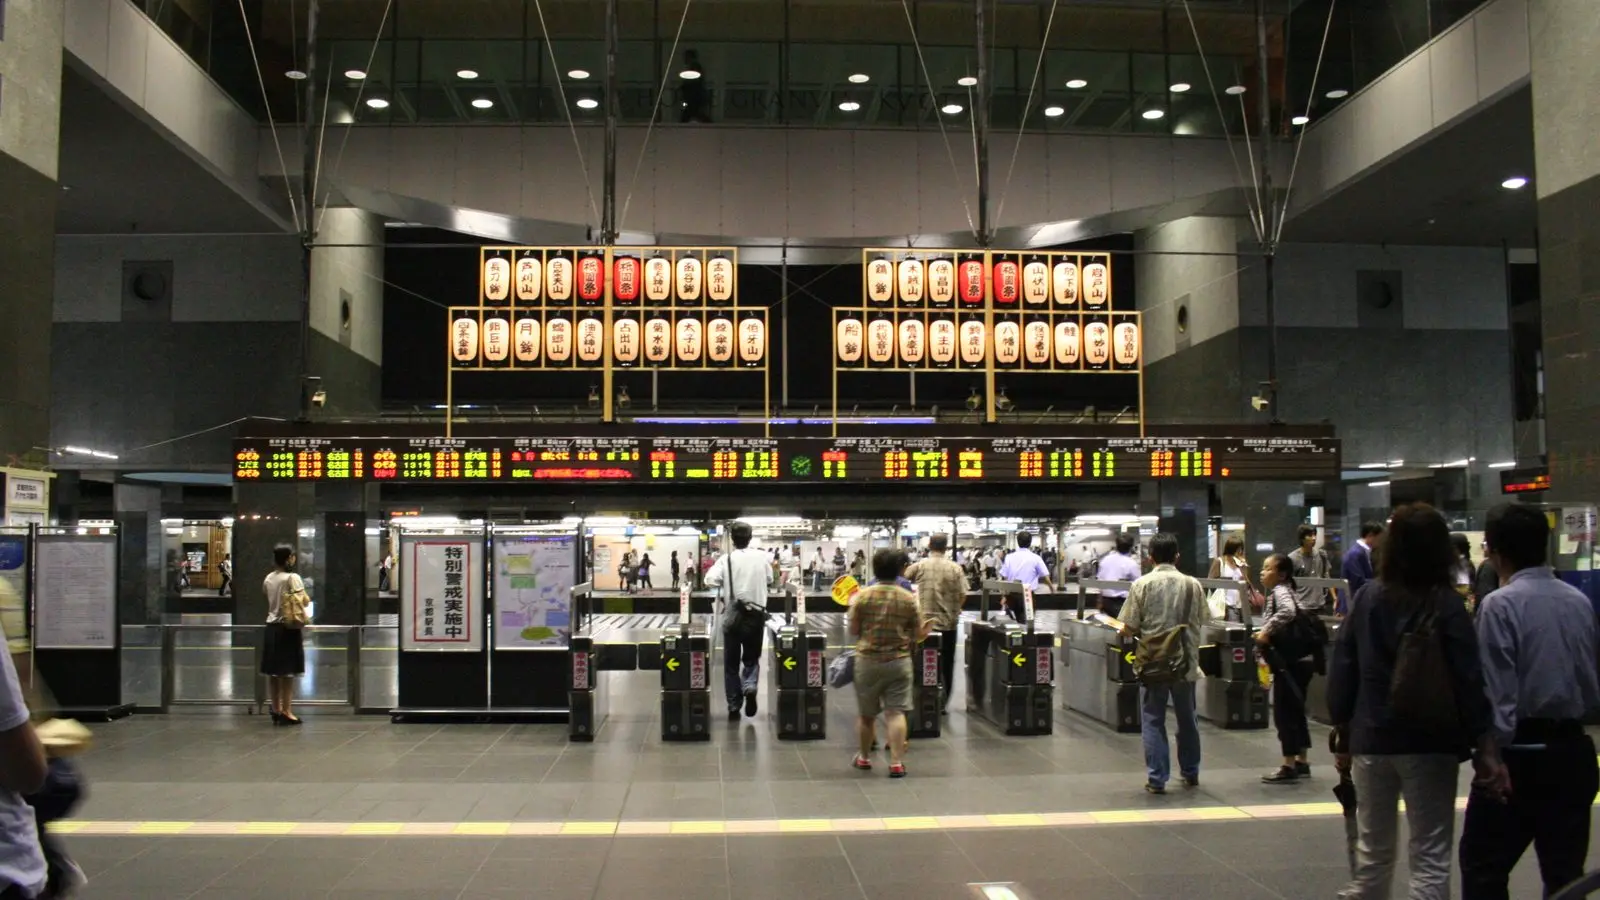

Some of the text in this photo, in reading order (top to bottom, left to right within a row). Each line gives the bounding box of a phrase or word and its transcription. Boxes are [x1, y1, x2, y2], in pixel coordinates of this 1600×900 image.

[489, 262, 501, 294] 長刀鉾
[520, 262, 533, 294] 芦刈山
[936, 264, 948, 296] 保昌山
[1032, 266, 1044, 296] 山伏山
[520, 322, 533, 355] 月鉾
[619, 322, 631, 356] 占出山
[652, 322, 664, 356] 菊水鉾
[683, 322, 695, 356] 太子山
[747, 323, 759, 356] 伯牙山
[844, 323, 859, 356] 船鉾
[1002, 327, 1015, 357] 八幡山
[1064, 326, 1076, 357] 鯉山
[236, 452, 363, 460] のぞみ 96号 22:15 名古屋 12
[238, 460, 259, 469] こだま
[327, 460, 349, 469] 名古屋
[354, 460, 363, 469] 12
[374, 452, 396, 460] のぞみ
[403, 452, 431, 460] 399号
[374, 460, 396, 469] のぞみ
[403, 460, 431, 469] 131号
[492, 460, 501, 469] 14
[771, 452, 778, 460] 2
[771, 460, 778, 469] 2
[941, 460, 948, 469] 4
[1075, 460, 1082, 469] 9
[236, 469, 260, 478] のぞみ
[273, 469, 294, 478] 98号
[327, 469, 349, 478] 名古屋
[354, 469, 363, 478] 12
[403, 469, 431, 478] 527号
[444, 546, 463, 638] 特別警戒実施中
[424, 598, 434, 636] 京都駅長
[692, 652, 703, 688] 乗車券のみ
[808, 652, 821, 687] 乗車券のみ
[925, 650, 936, 685] 乗車券のみ
[1038, 648, 1049, 683] 乗車券のみ
